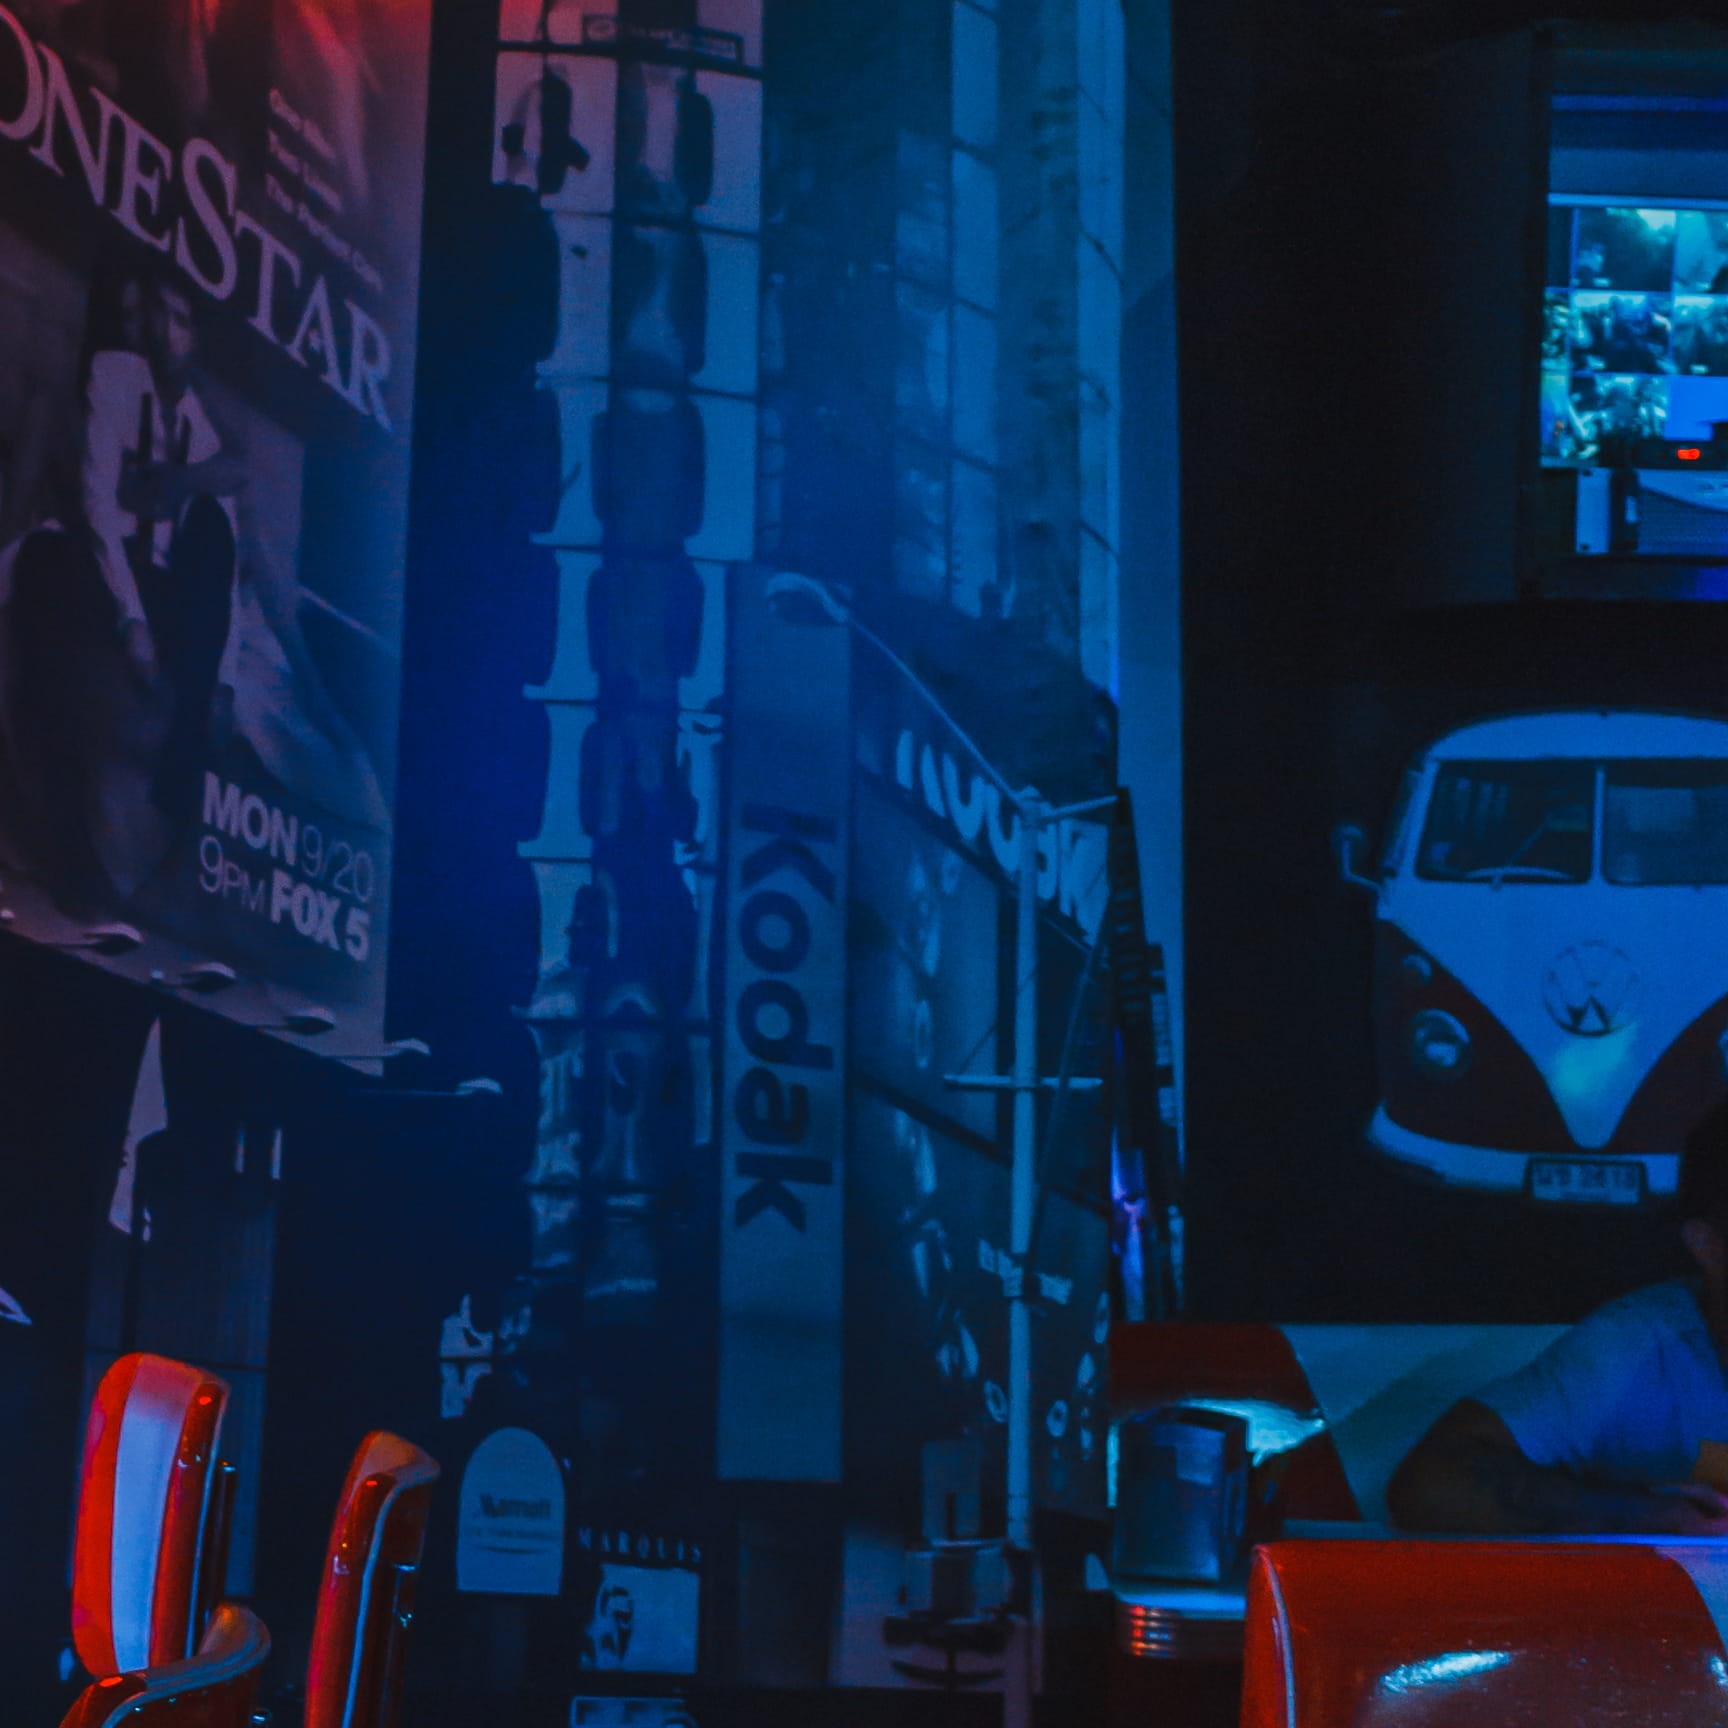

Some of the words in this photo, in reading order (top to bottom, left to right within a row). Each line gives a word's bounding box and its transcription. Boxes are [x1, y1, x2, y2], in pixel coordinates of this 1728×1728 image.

[199, 834, 266, 914] 9PM
[202, 770, 299, 866] MON
[301, 823, 372, 904] 9/20
[734, 802, 836, 1234] Kodak
